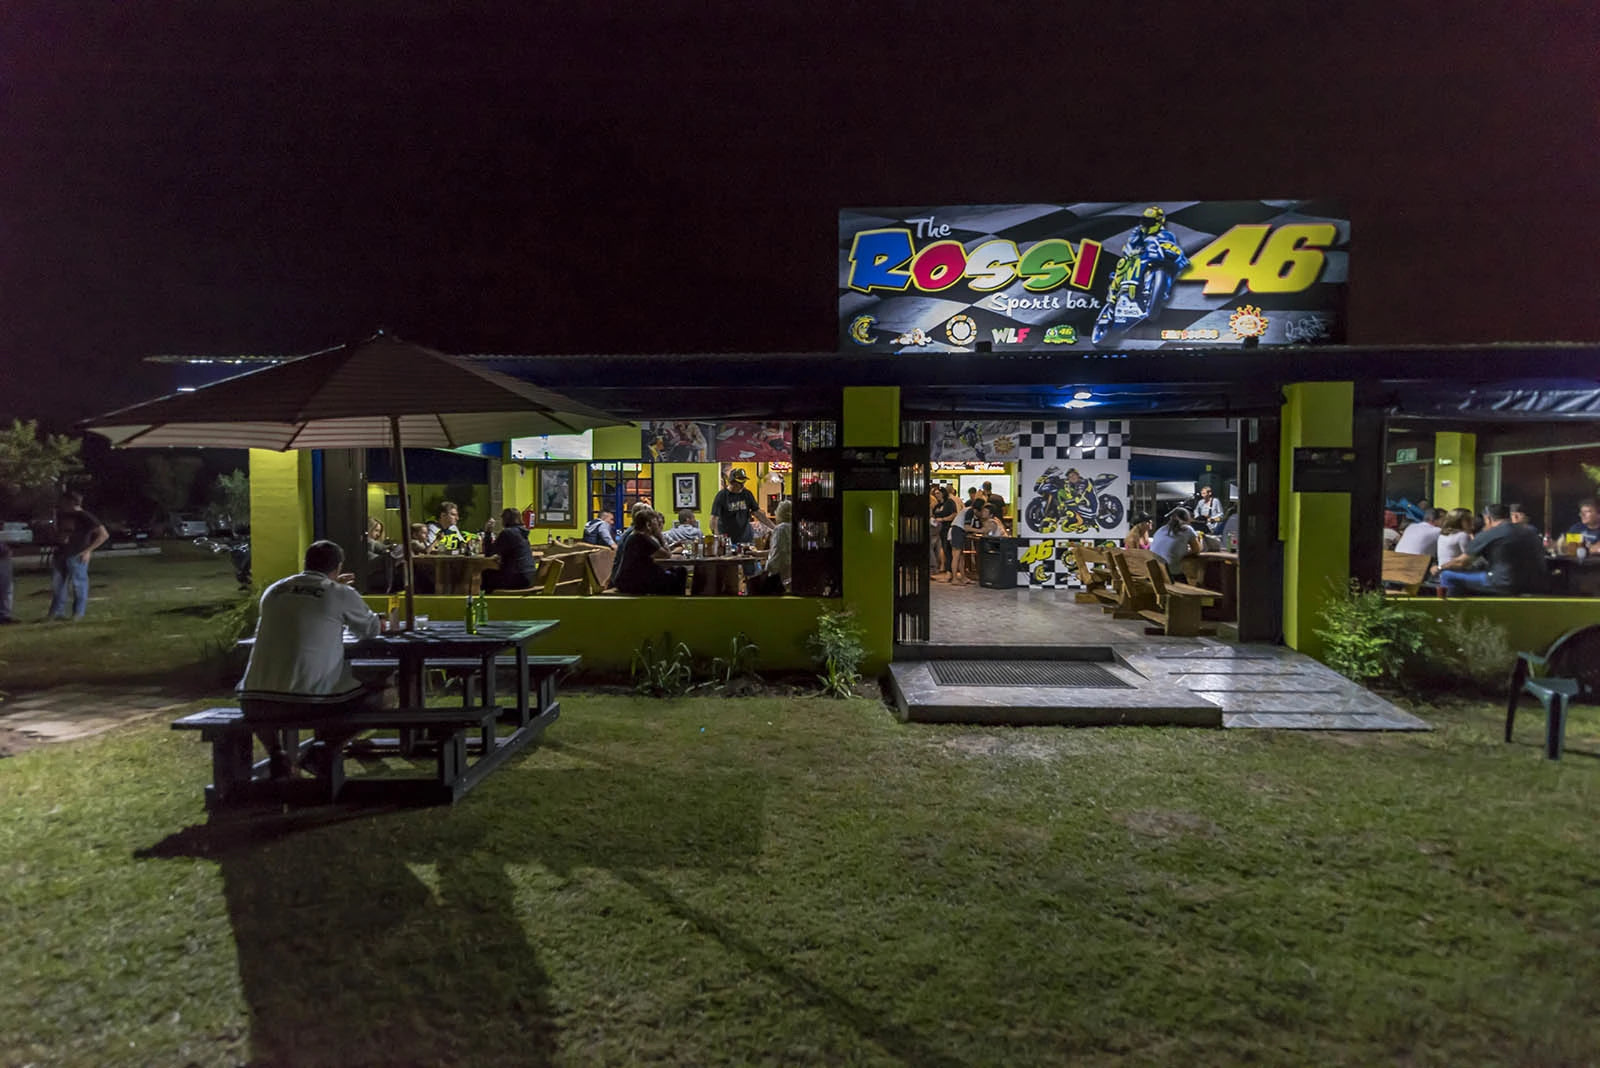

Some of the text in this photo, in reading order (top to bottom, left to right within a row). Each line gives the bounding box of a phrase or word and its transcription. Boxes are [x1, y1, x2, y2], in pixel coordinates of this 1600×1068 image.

[904, 216, 951, 238] The
[848, 228, 1102, 293] ROSSI
[1177, 223, 1336, 295] 46
[988, 291, 1101, 316] Sports bar
[992, 327, 1031, 344] WLF
[1058, 327, 1074, 335] 46
[1020, 539, 1054, 564] 46
